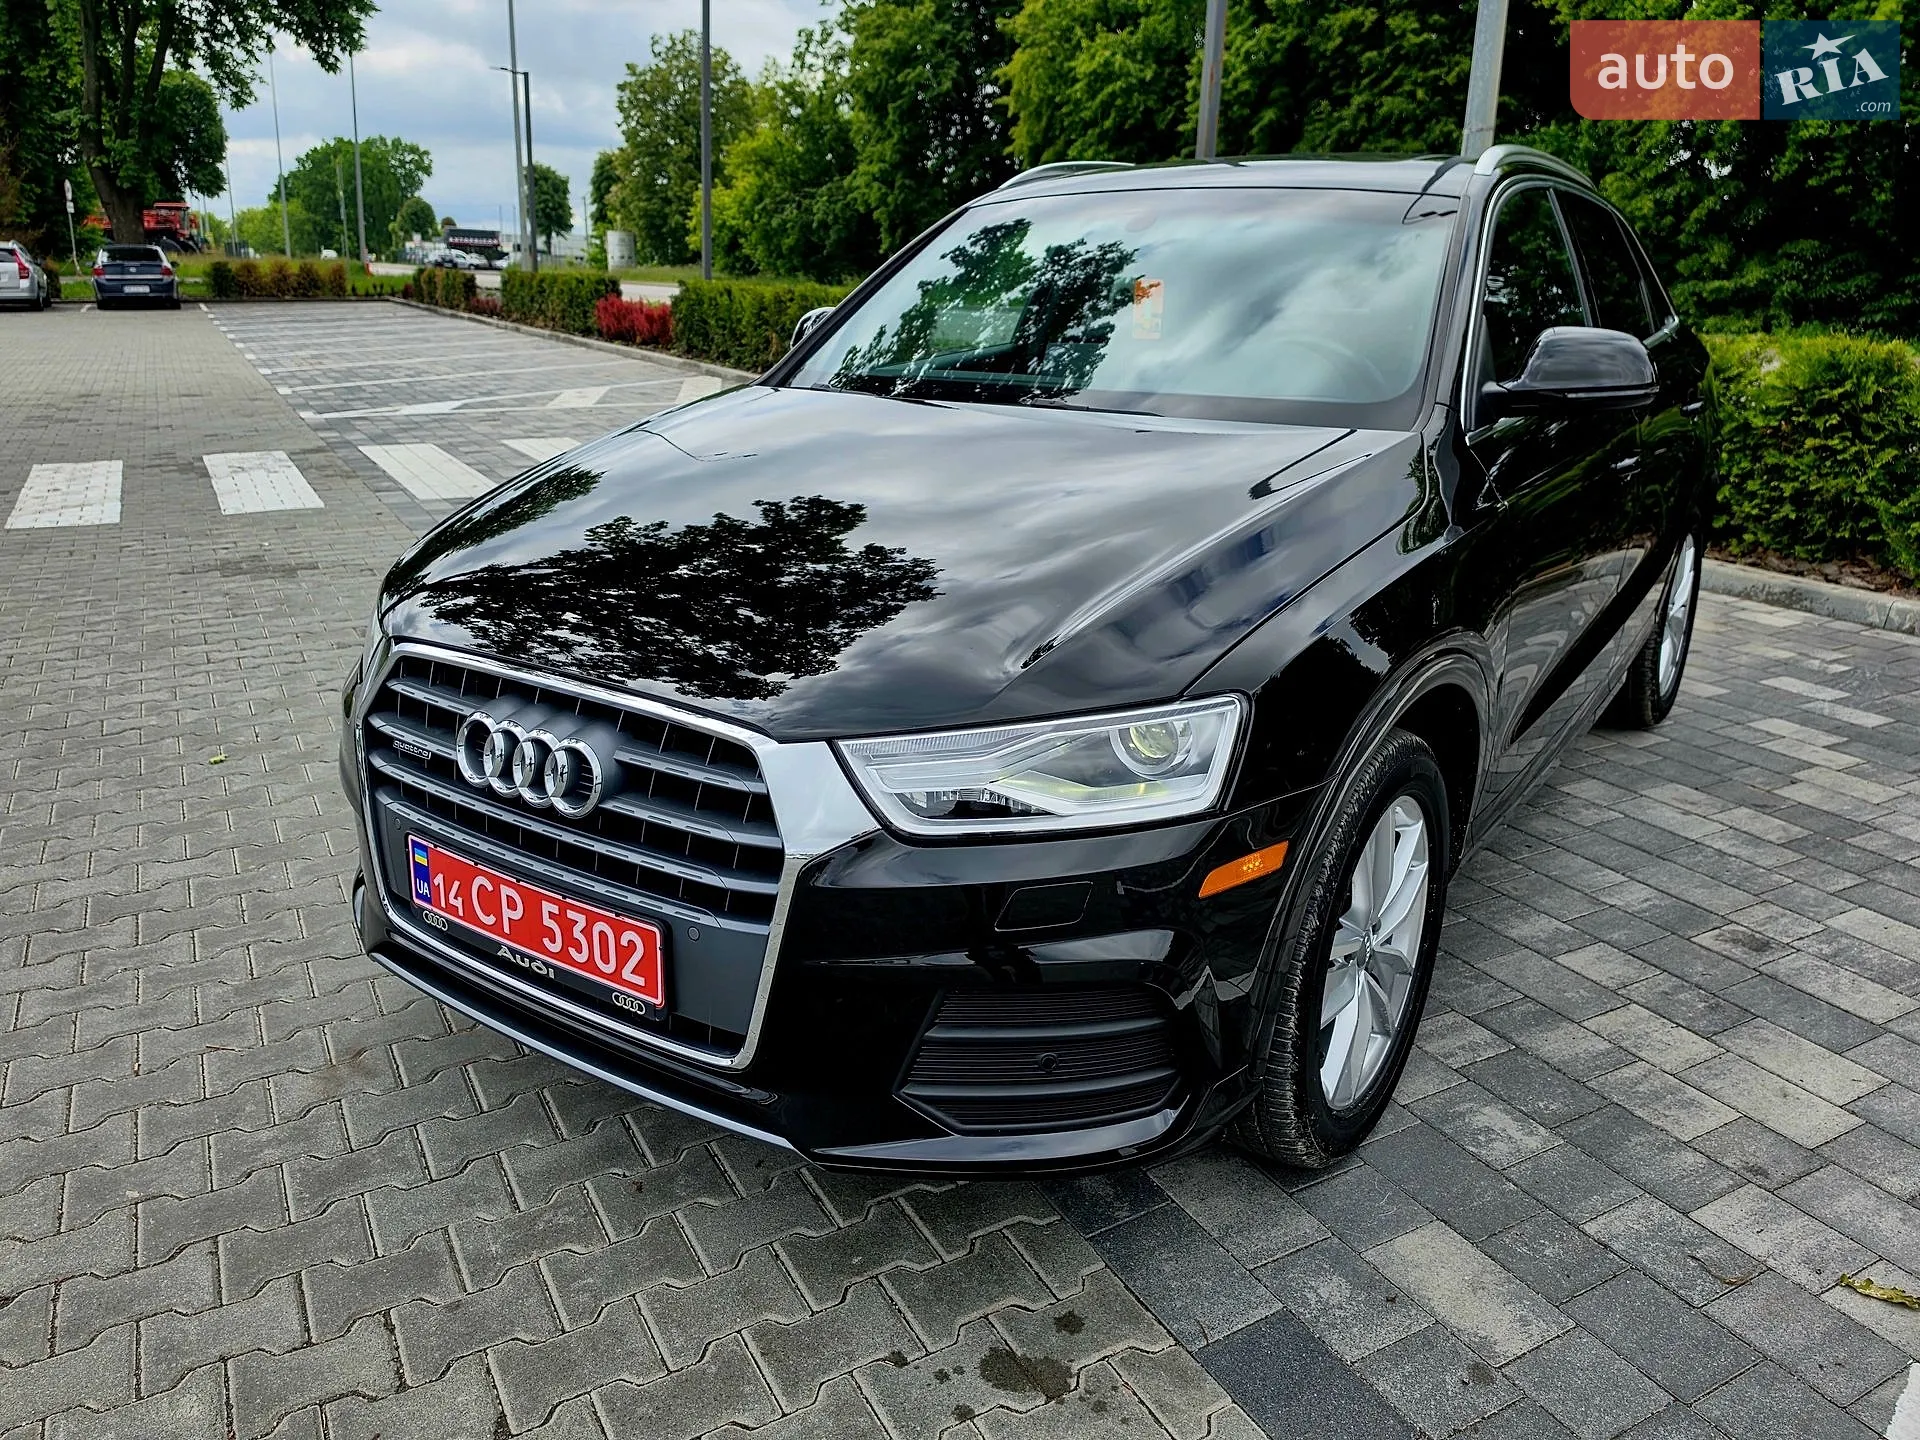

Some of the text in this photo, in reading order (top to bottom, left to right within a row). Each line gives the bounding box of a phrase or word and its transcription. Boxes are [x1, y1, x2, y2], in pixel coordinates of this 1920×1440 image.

[416, 878, 430, 898] UA
[541, 900, 646, 987] 5302
[496, 944, 555, 980] Audi
